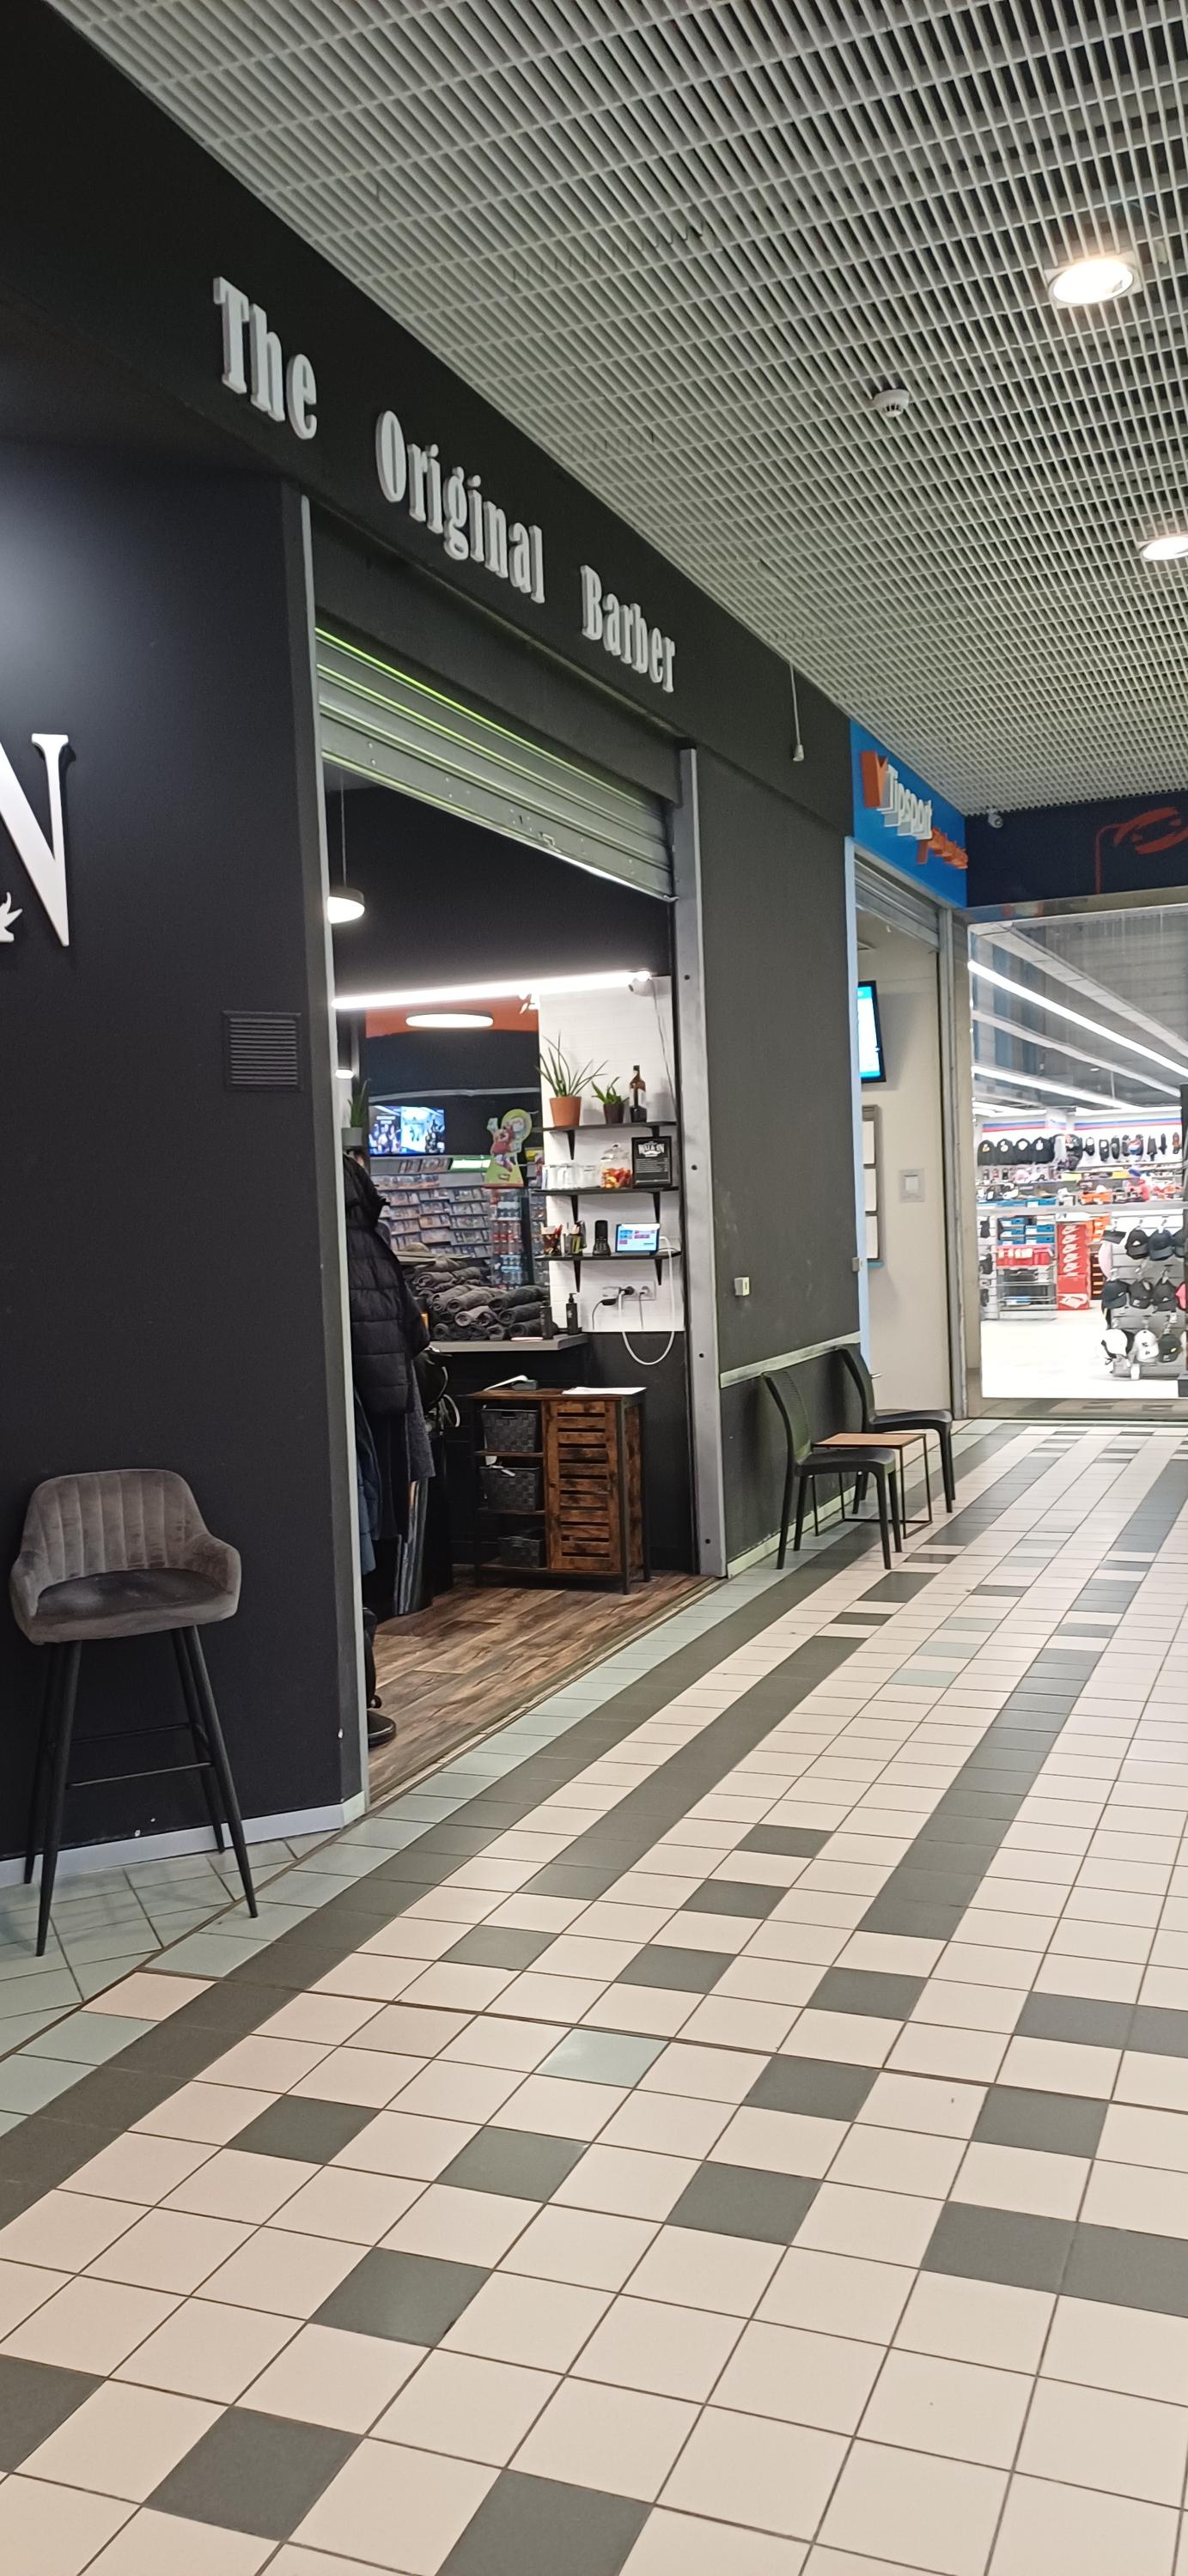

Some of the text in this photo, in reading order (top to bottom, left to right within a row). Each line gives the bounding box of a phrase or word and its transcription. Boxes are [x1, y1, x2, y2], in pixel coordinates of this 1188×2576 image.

[213, 276, 675, 692] The Original Barber
